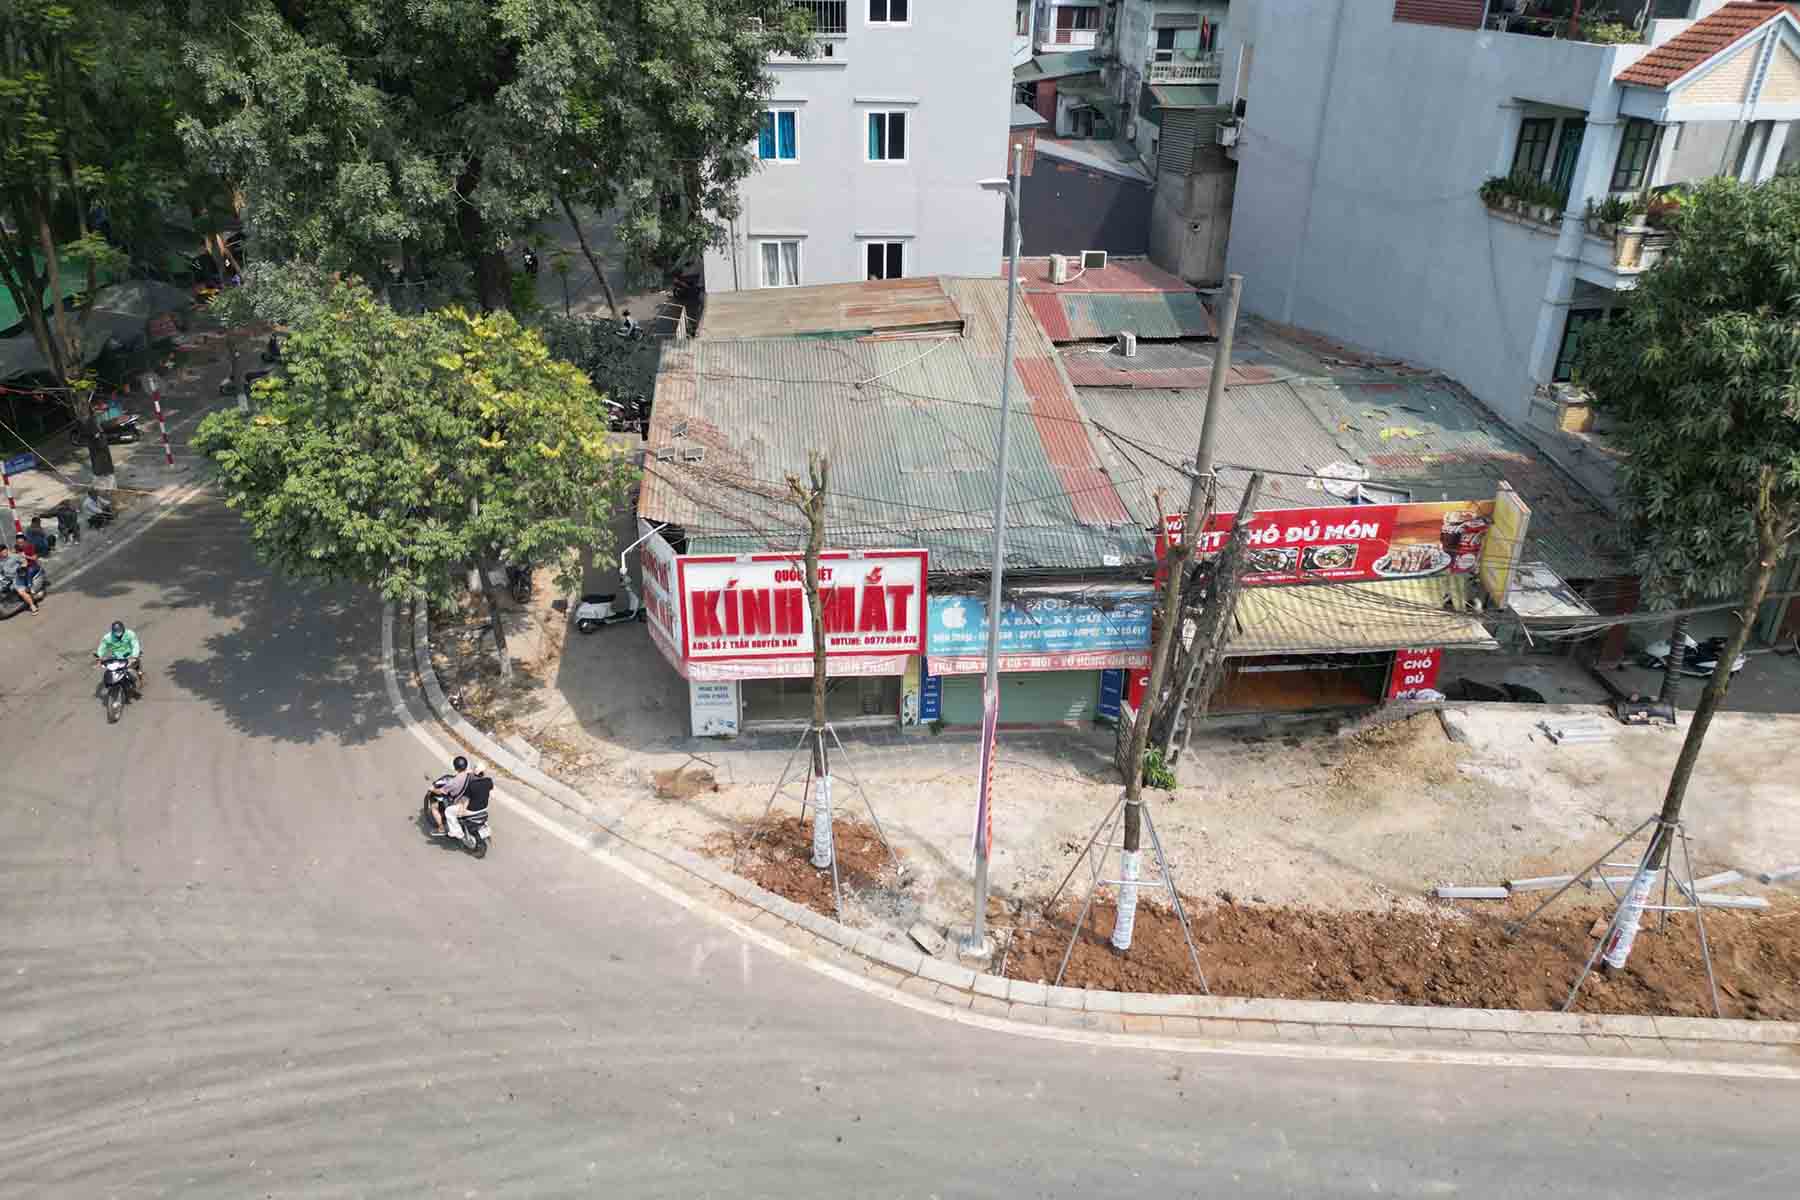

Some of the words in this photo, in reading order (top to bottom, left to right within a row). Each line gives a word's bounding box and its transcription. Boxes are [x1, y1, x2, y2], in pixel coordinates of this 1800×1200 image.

[1246, 523, 1281, 545] HÓ
[1285, 520, 1320, 543] ĐỦ
[1324, 519, 1379, 541] MÓN
[690, 578, 804, 637] KÍNH
[817, 566, 914, 635] MẮT
[1403, 656, 1432, 670] CHÓ
[1404, 671, 1425, 685] ĐỦ
